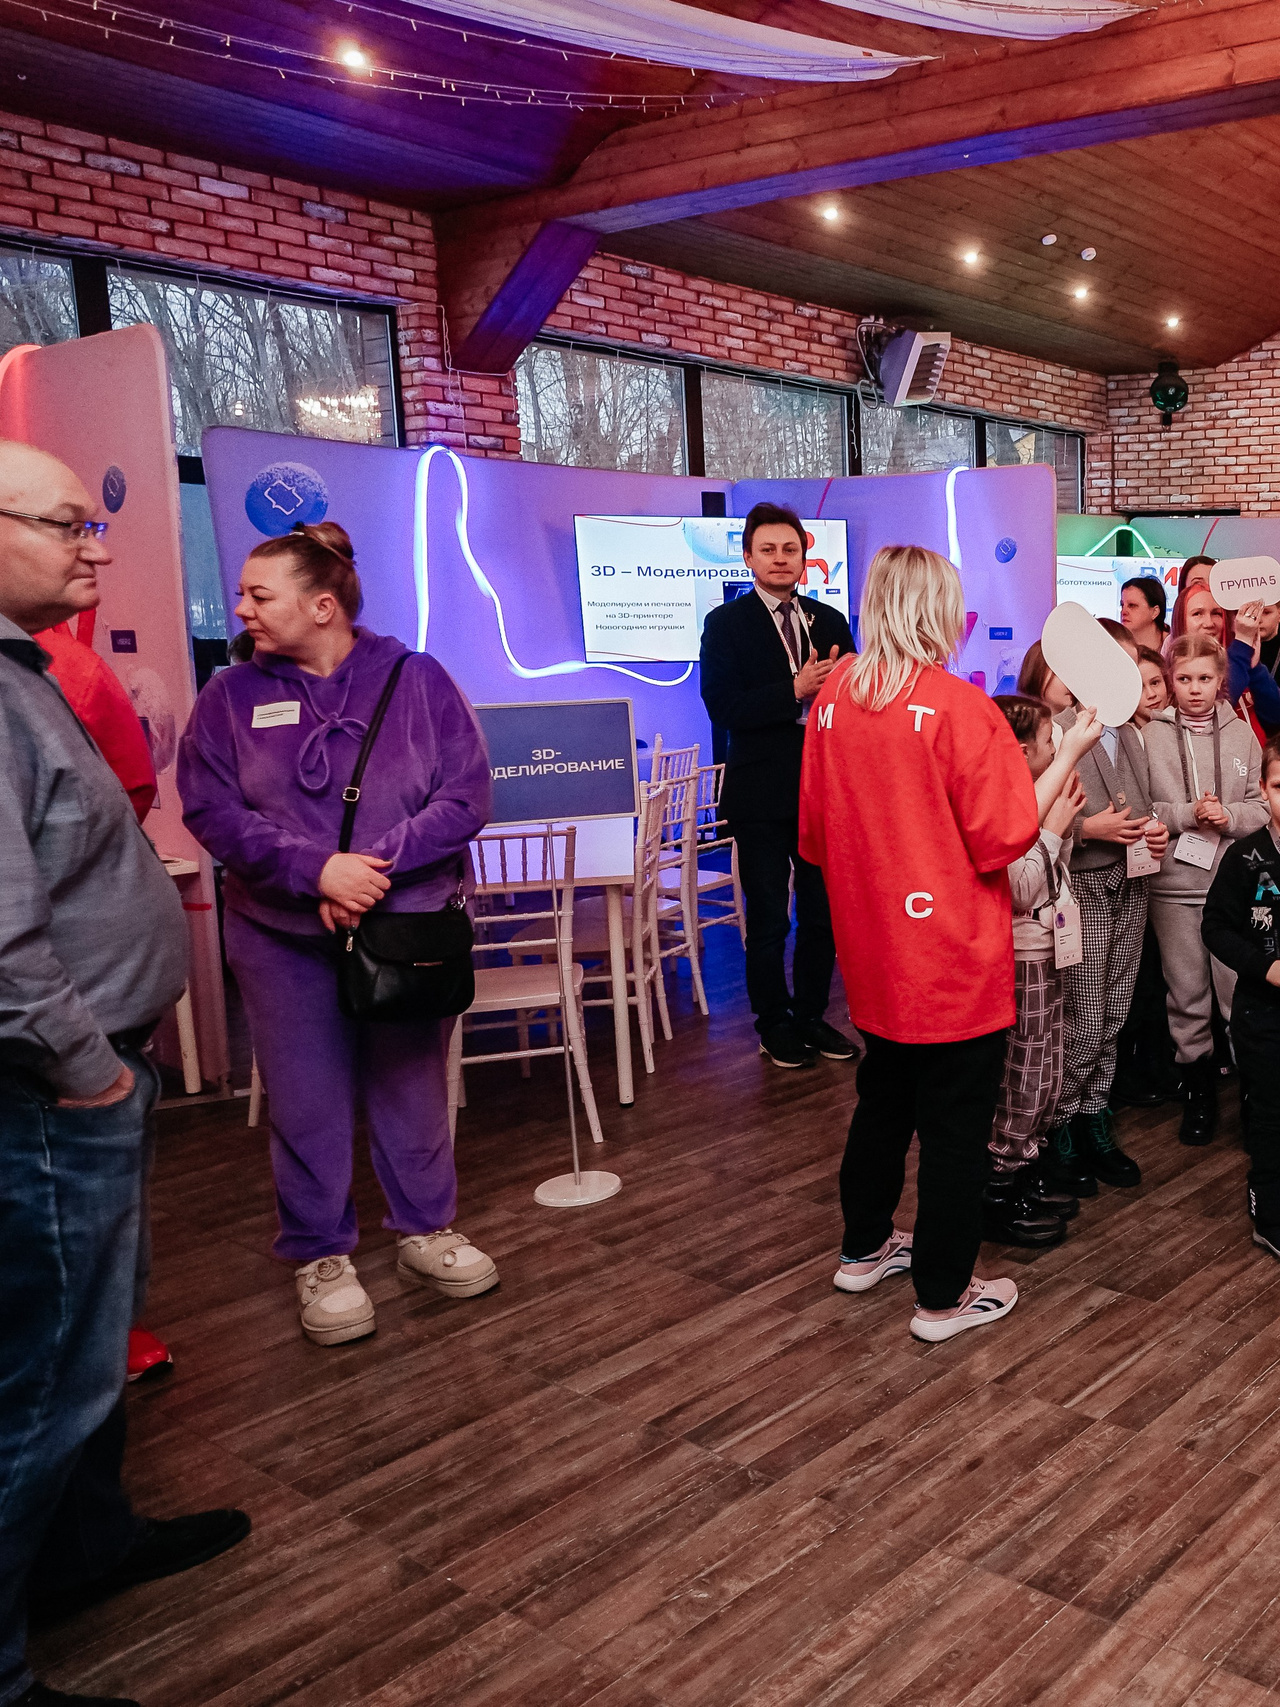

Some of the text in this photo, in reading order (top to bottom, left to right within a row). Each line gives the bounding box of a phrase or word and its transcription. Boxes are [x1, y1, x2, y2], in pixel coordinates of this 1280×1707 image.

[590, 565, 616, 577] 3D
[636, 565, 756, 580] Моделирова
[1056, 578, 1113, 587] бототехника
[1220, 575, 1277, 592] ГРУППА 5
[587, 601, 643, 609] Моделируем
[617, 612, 674, 620] 3D-принтере
[531, 748, 562, 761] 3D-
[489, 758, 626, 780] ДЕЛИРОВАНИЕ
